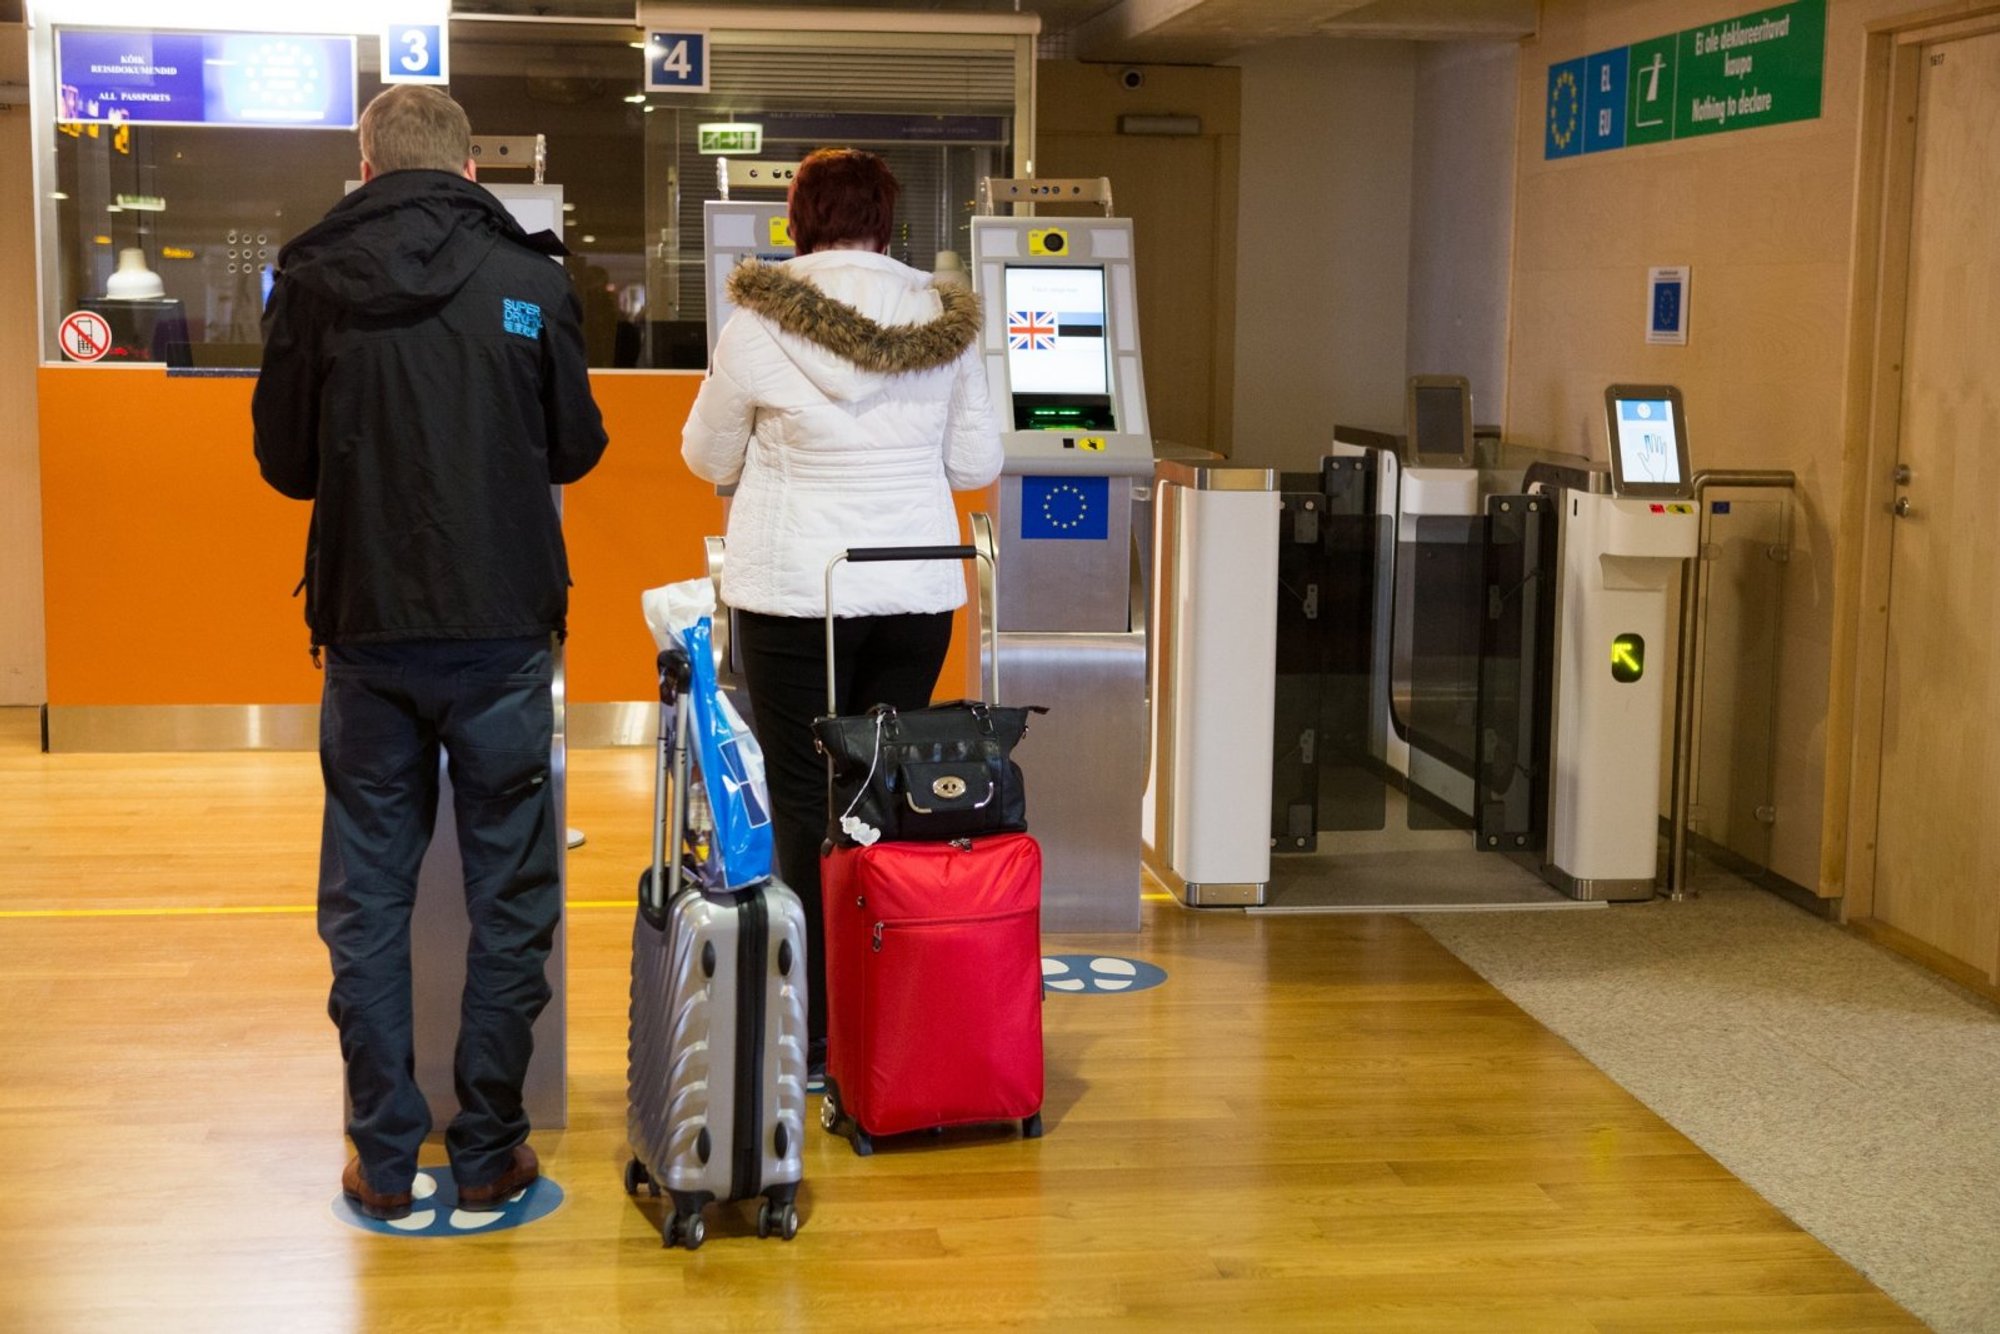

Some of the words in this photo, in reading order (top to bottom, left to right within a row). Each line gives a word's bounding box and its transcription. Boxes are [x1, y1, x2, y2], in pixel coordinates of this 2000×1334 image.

[401, 29, 429, 72] 3
[1695, 32, 1704, 56] Ei
[1705, 27, 1719, 54] ole
[663, 39, 692, 79] 4
[99, 92, 117, 101] ALL
[121, 92, 171, 102] PASSPORTS
[1692, 94, 1726, 125] Nothing
[1727, 95, 1737, 117] to
[1738, 87, 1772, 114] declare
[1599, 109, 1612, 136] EU
[504, 298, 540, 317] SUPER
